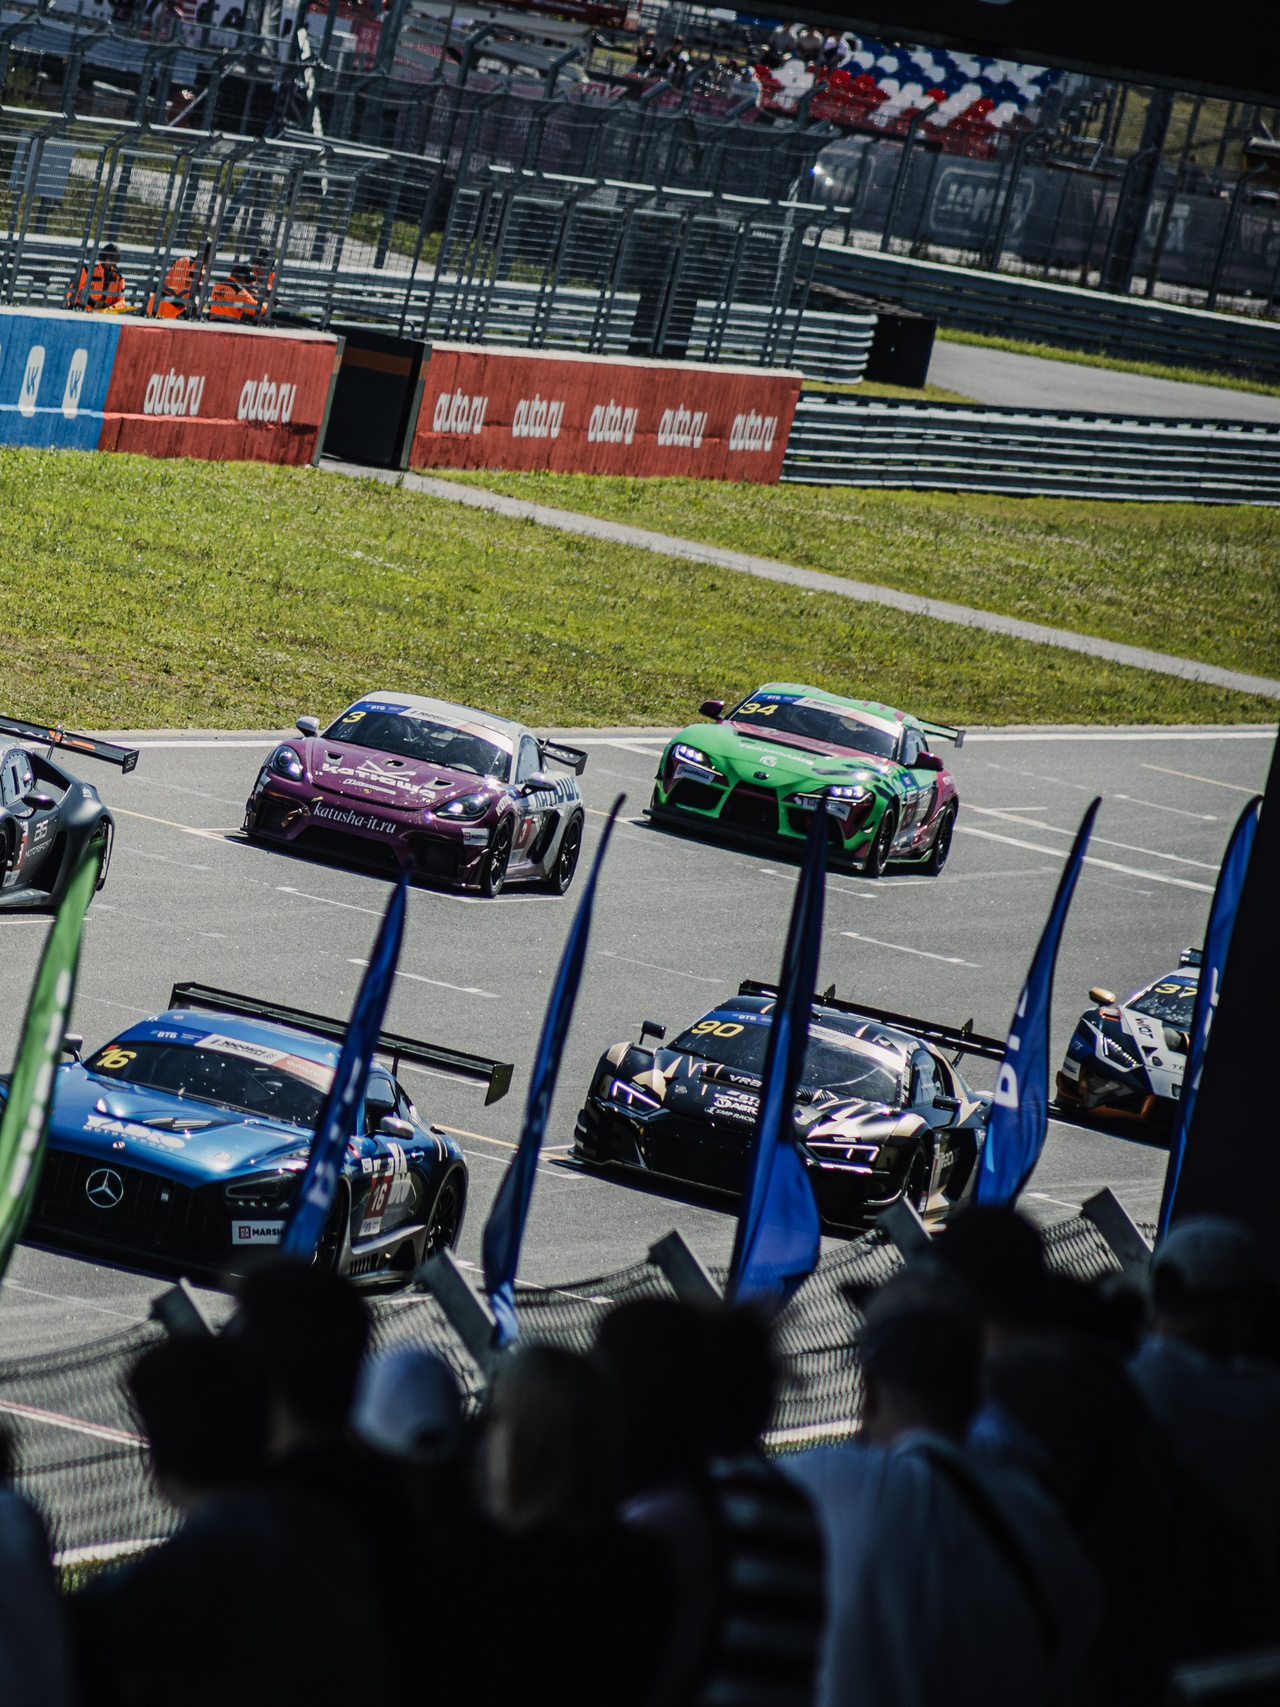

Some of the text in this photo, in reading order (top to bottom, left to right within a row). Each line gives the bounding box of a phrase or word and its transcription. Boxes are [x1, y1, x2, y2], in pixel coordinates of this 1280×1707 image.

[143, 367, 205, 416] auto.ru
[237, 374, 297, 424] auto.ru
[432, 387, 488, 435] auto.ru
[512, 392, 565, 438] auto.ru
[587, 398, 638, 445] auto.ru
[657, 402, 708, 449] auto.ru
[728, 408, 778, 452] auto.ru
[342, 711, 367, 723] 3
[738, 702, 779, 716] 34
[683, 768, 710, 780] MARSHALL
[314, 801, 397, 834] katusha-it.ru
[519, 821, 528, 844] 3
[691, 1020, 744, 1038] 90
[95, 1048, 137, 1068] 16
[371, 1181, 387, 1212] 16
